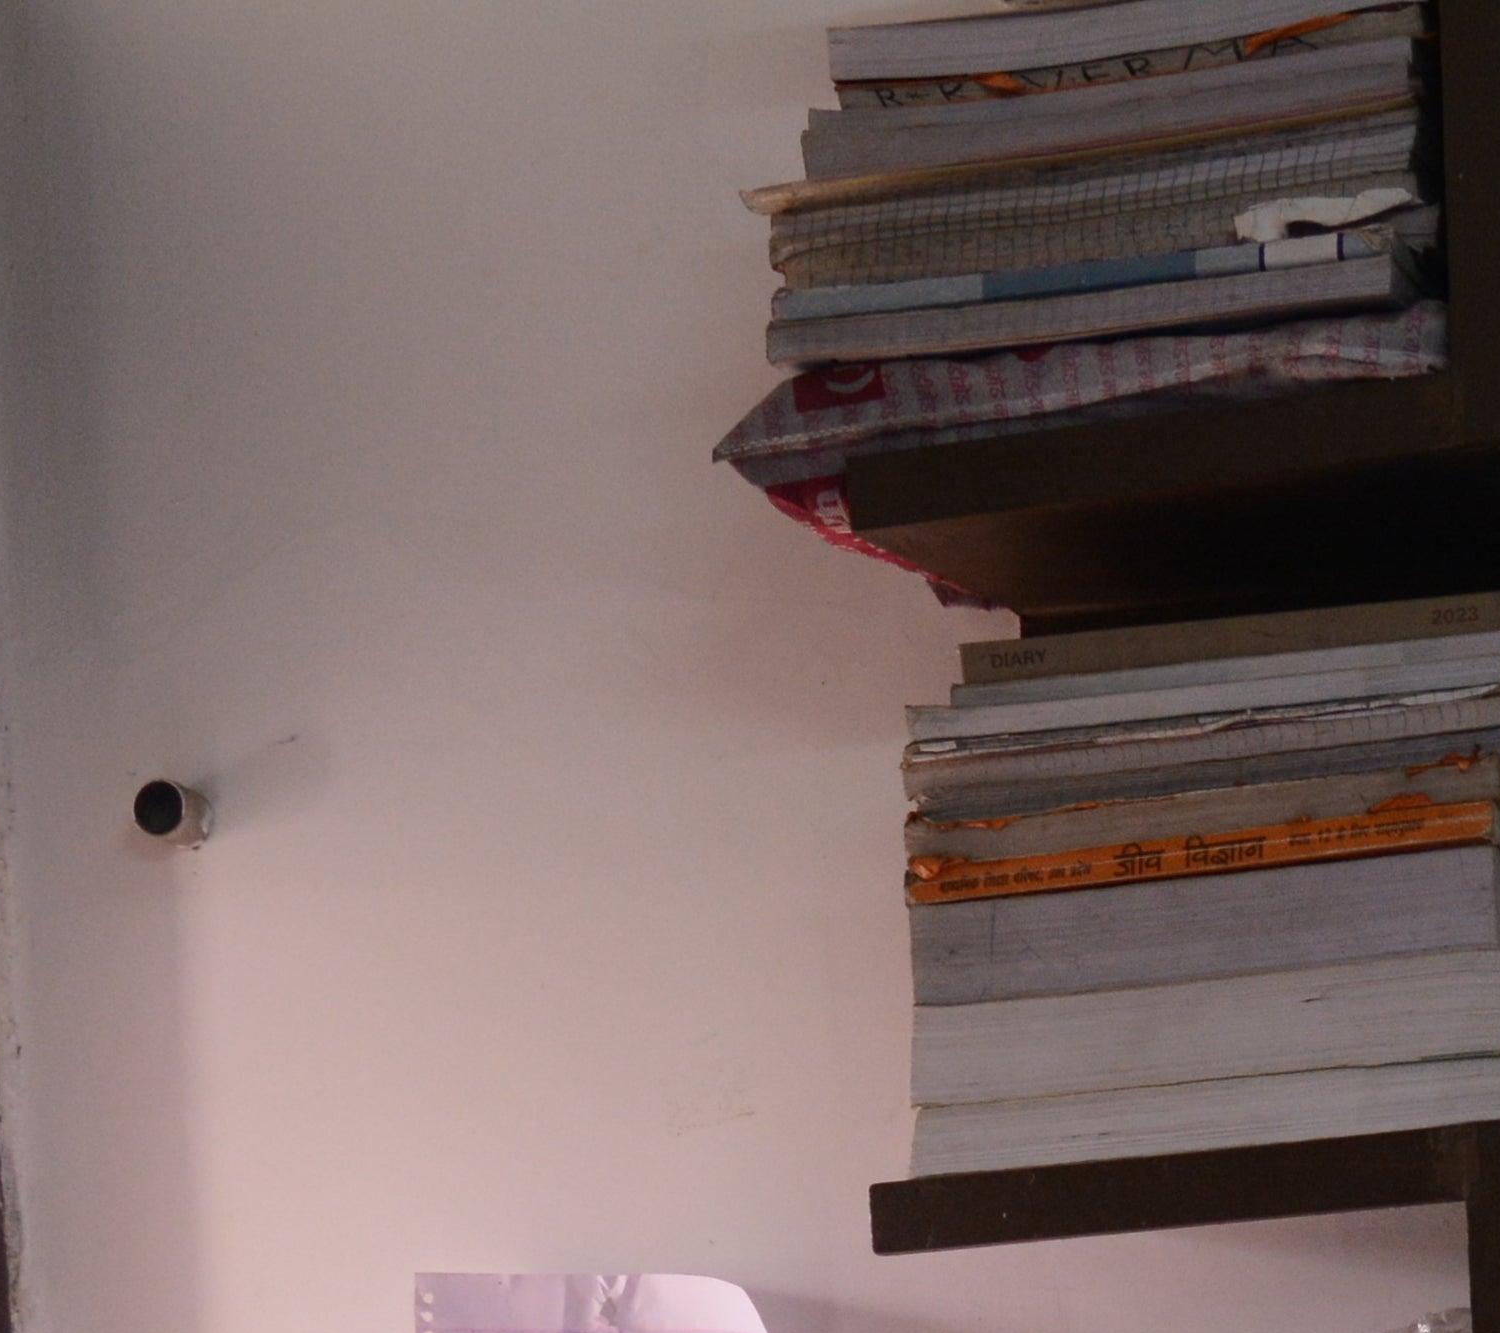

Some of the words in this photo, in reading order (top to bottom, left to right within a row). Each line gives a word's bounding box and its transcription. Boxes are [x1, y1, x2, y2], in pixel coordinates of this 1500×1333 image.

[1431, 605, 1480, 625] 2023
[990, 648, 1047, 669] DIARY
[1113, 843, 1165, 878] जीव
[1184, 836, 1267, 869] विज्ञान
